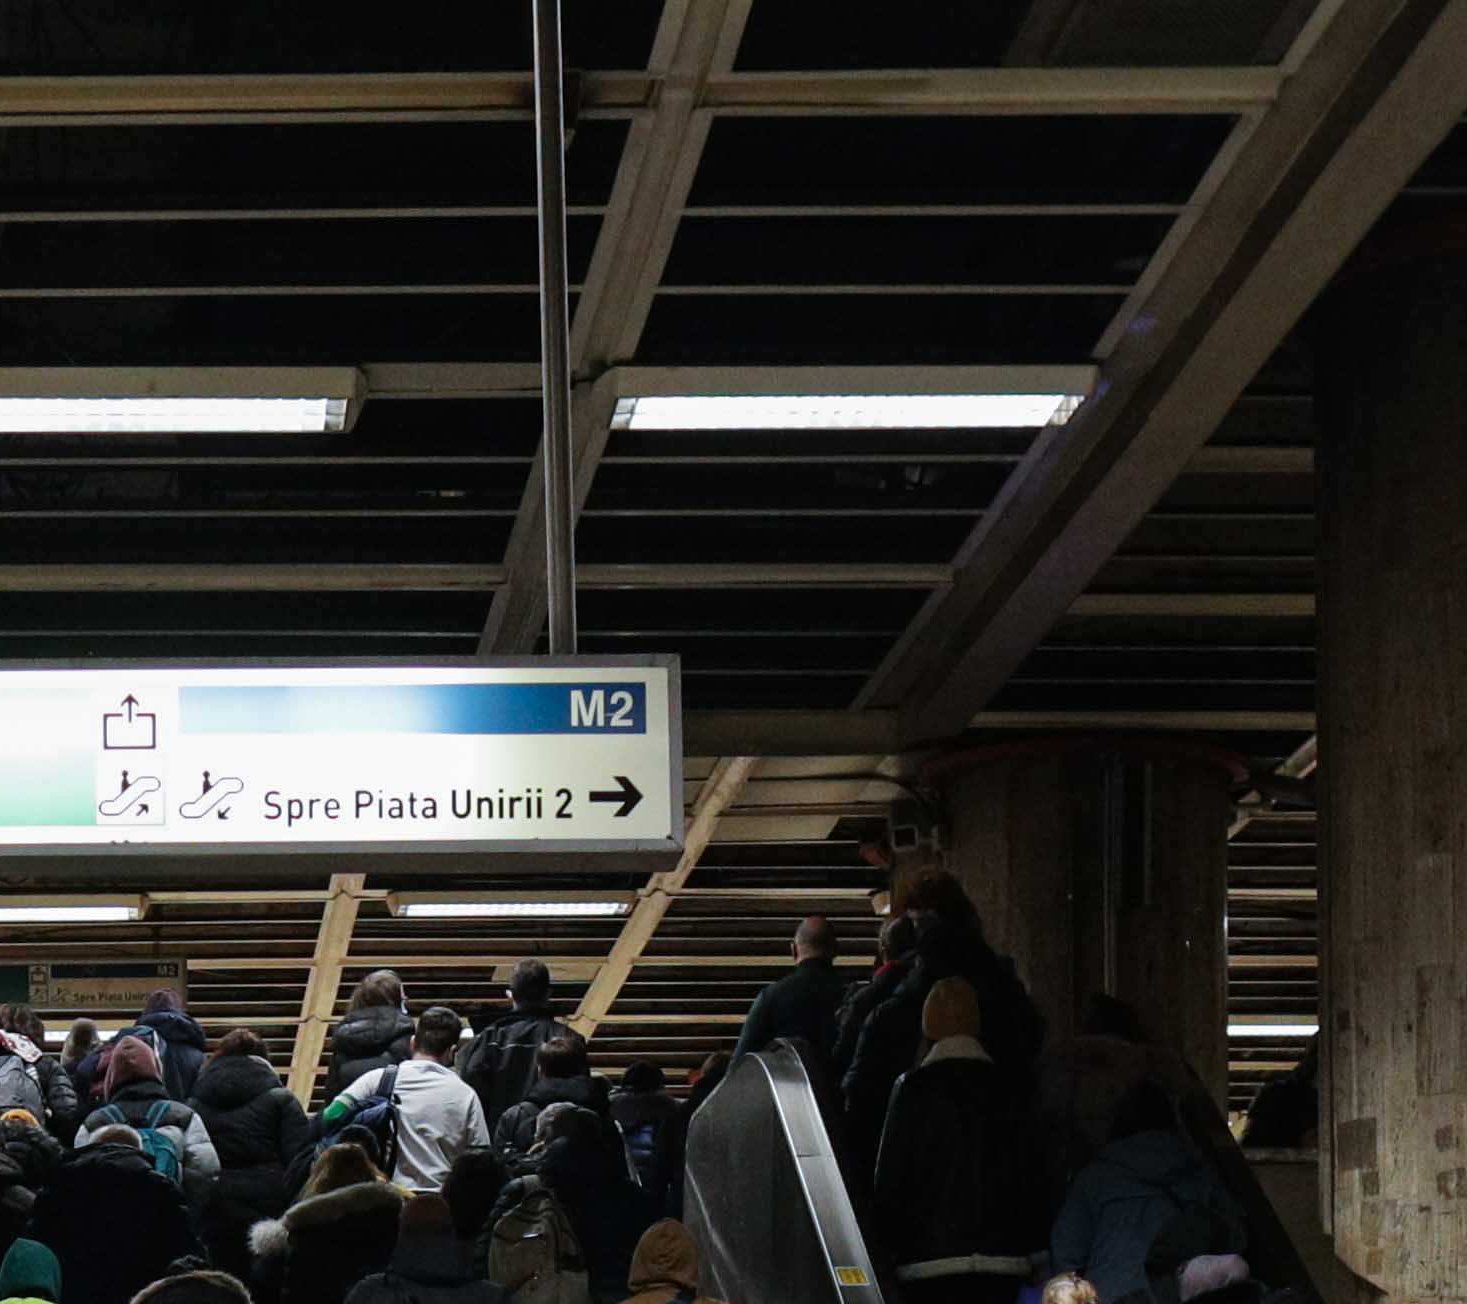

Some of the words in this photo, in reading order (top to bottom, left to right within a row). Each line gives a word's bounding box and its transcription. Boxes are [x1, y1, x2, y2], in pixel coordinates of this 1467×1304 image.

[569, 689, 634, 728] M2
[263, 789, 342, 828] Spre
[354, 788, 439, 819] Piata
[451, 788, 543, 819] Unirii
[555, 787, 574, 819] 2
[157, 965, 175, 976] M2
